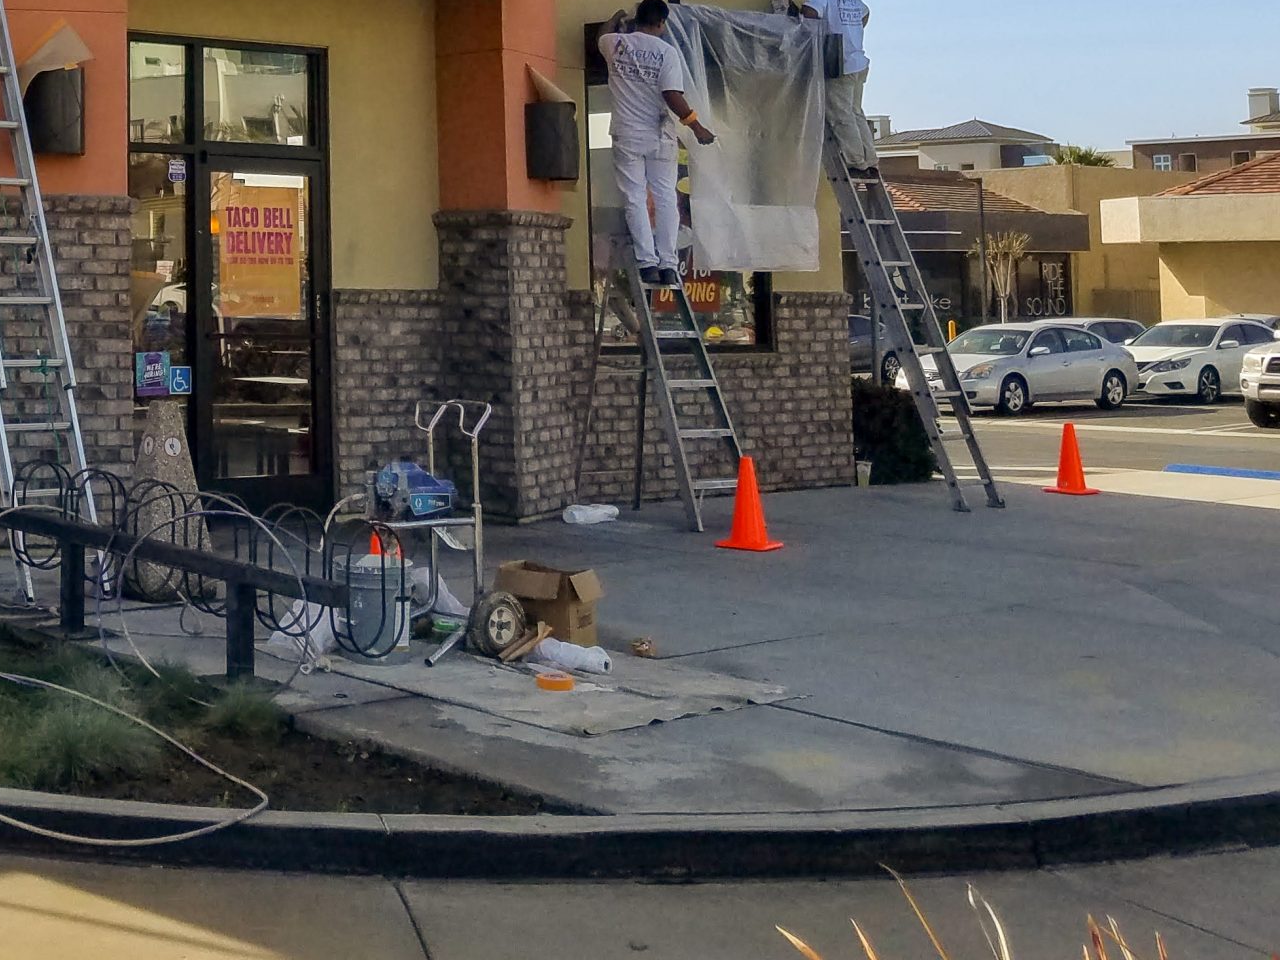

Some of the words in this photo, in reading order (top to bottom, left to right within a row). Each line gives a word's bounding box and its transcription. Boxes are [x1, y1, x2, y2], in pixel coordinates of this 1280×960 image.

[225, 206, 259, 228] TACO
[263, 207, 294, 229] BELL
[225, 231, 293, 254] DELIVERY
[1041, 262, 1064, 281] RIDE
[659, 282, 716, 302] DIPING
[1047, 280, 1065, 298] THE
[1027, 297, 1066, 316] SOUND
